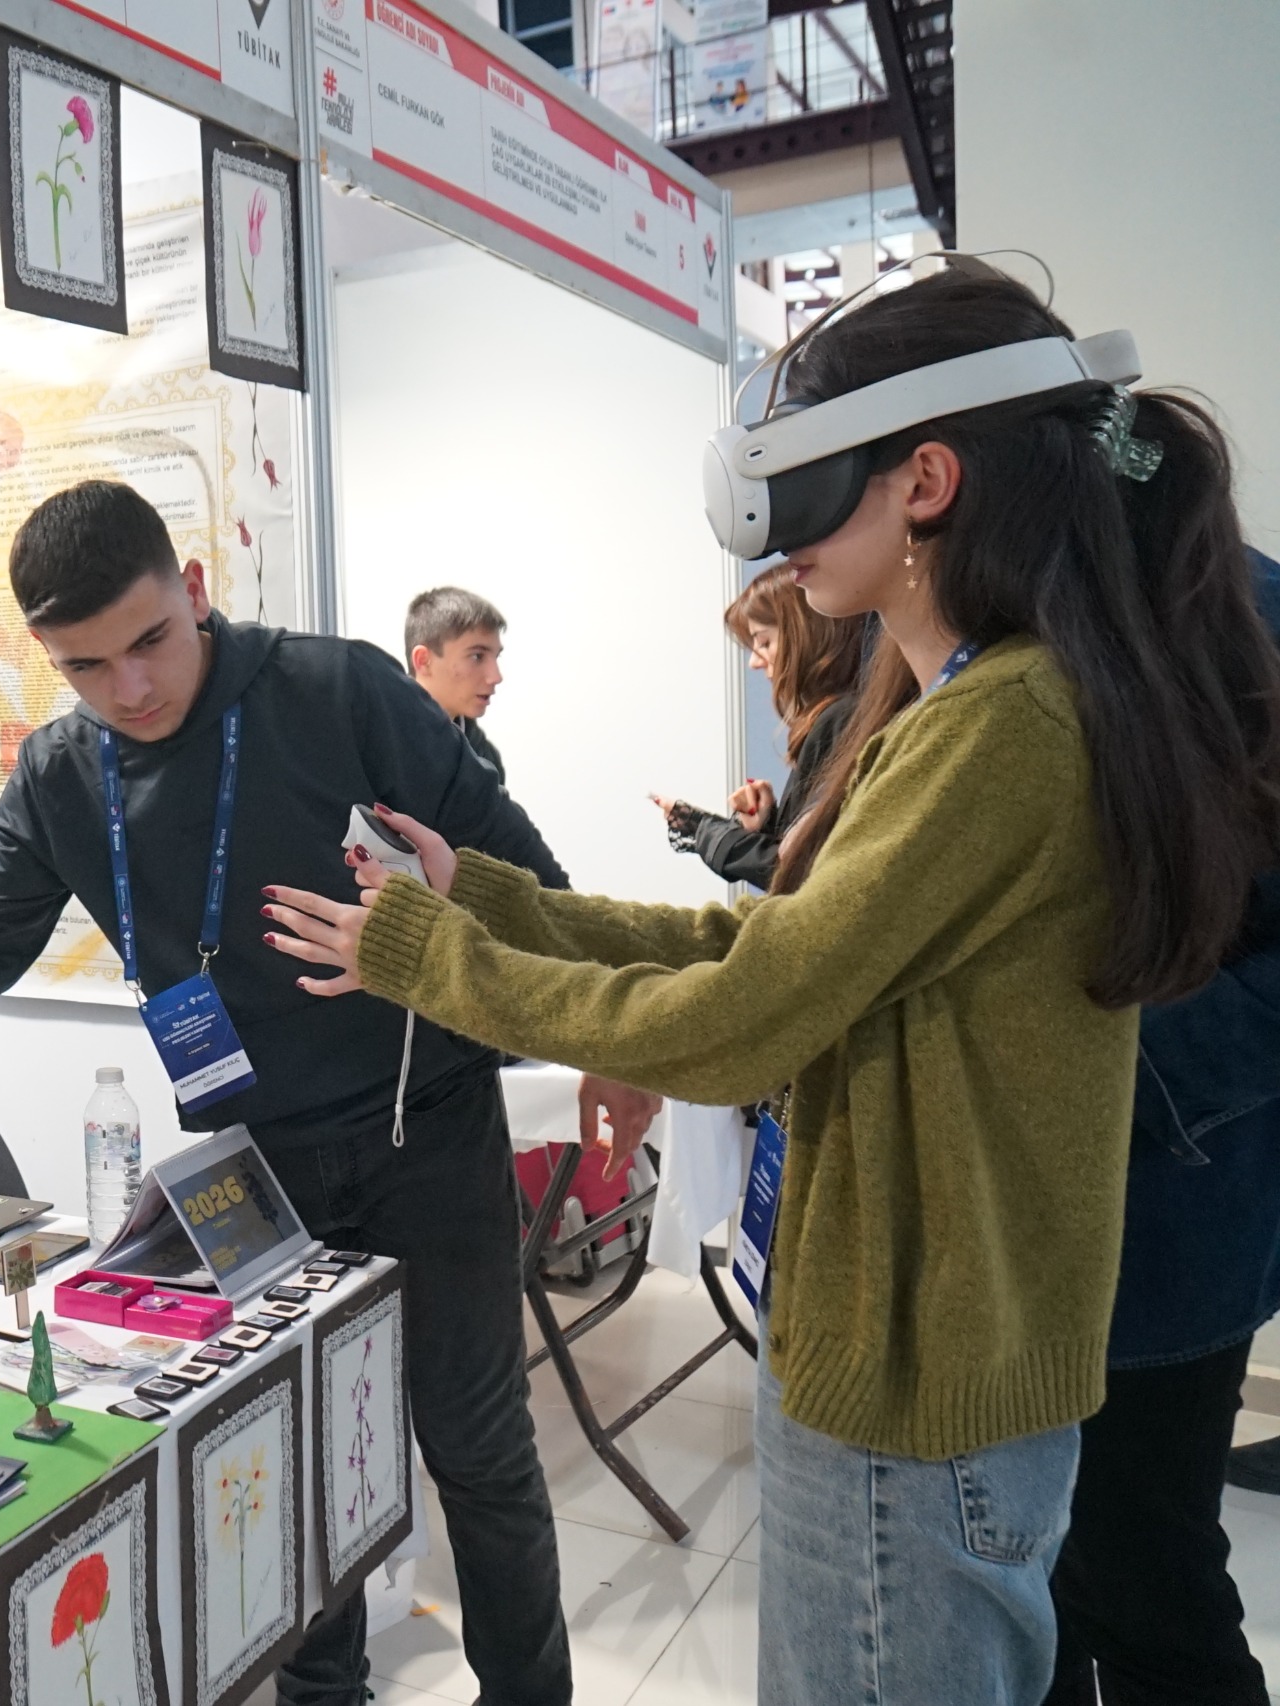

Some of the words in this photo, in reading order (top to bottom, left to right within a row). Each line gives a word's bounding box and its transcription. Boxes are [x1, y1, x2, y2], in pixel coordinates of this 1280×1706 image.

[238, 30, 281, 69] TÜBİTAK
[378, 82, 399, 105] CEMİL
[401, 94, 429, 121] FURKAN
[430, 110, 445, 128] GÖK
[156, 235, 189, 249] geliştirilen
[134, 256, 151, 266] çiçek
[152, 248, 187, 261] kültürünün
[173, 423, 196, 433] tasarım
[182, 1175, 245, 1227] 2026
